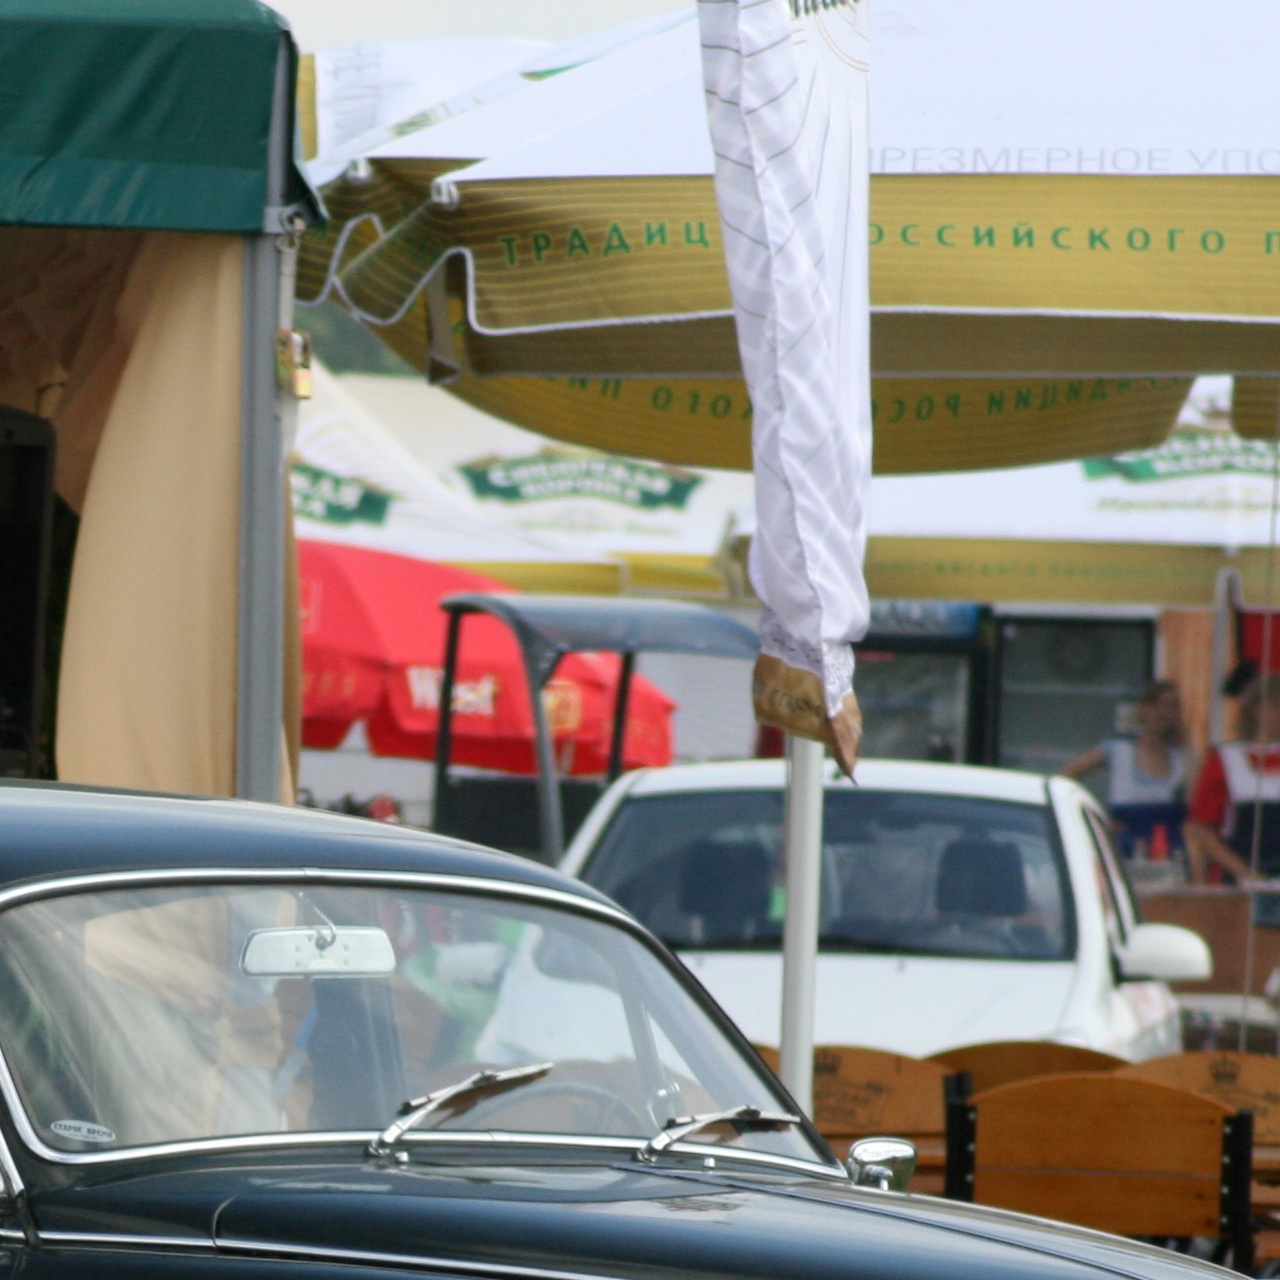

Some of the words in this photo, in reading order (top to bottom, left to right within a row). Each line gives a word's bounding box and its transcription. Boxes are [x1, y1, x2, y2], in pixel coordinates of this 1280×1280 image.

[867, 146, 1171, 172] РЕЗМЕРНОЕ
[499, 220, 710, 267] ТРАДИЦ
[869, 221, 1226, 255] ОССИЙСКОГО
